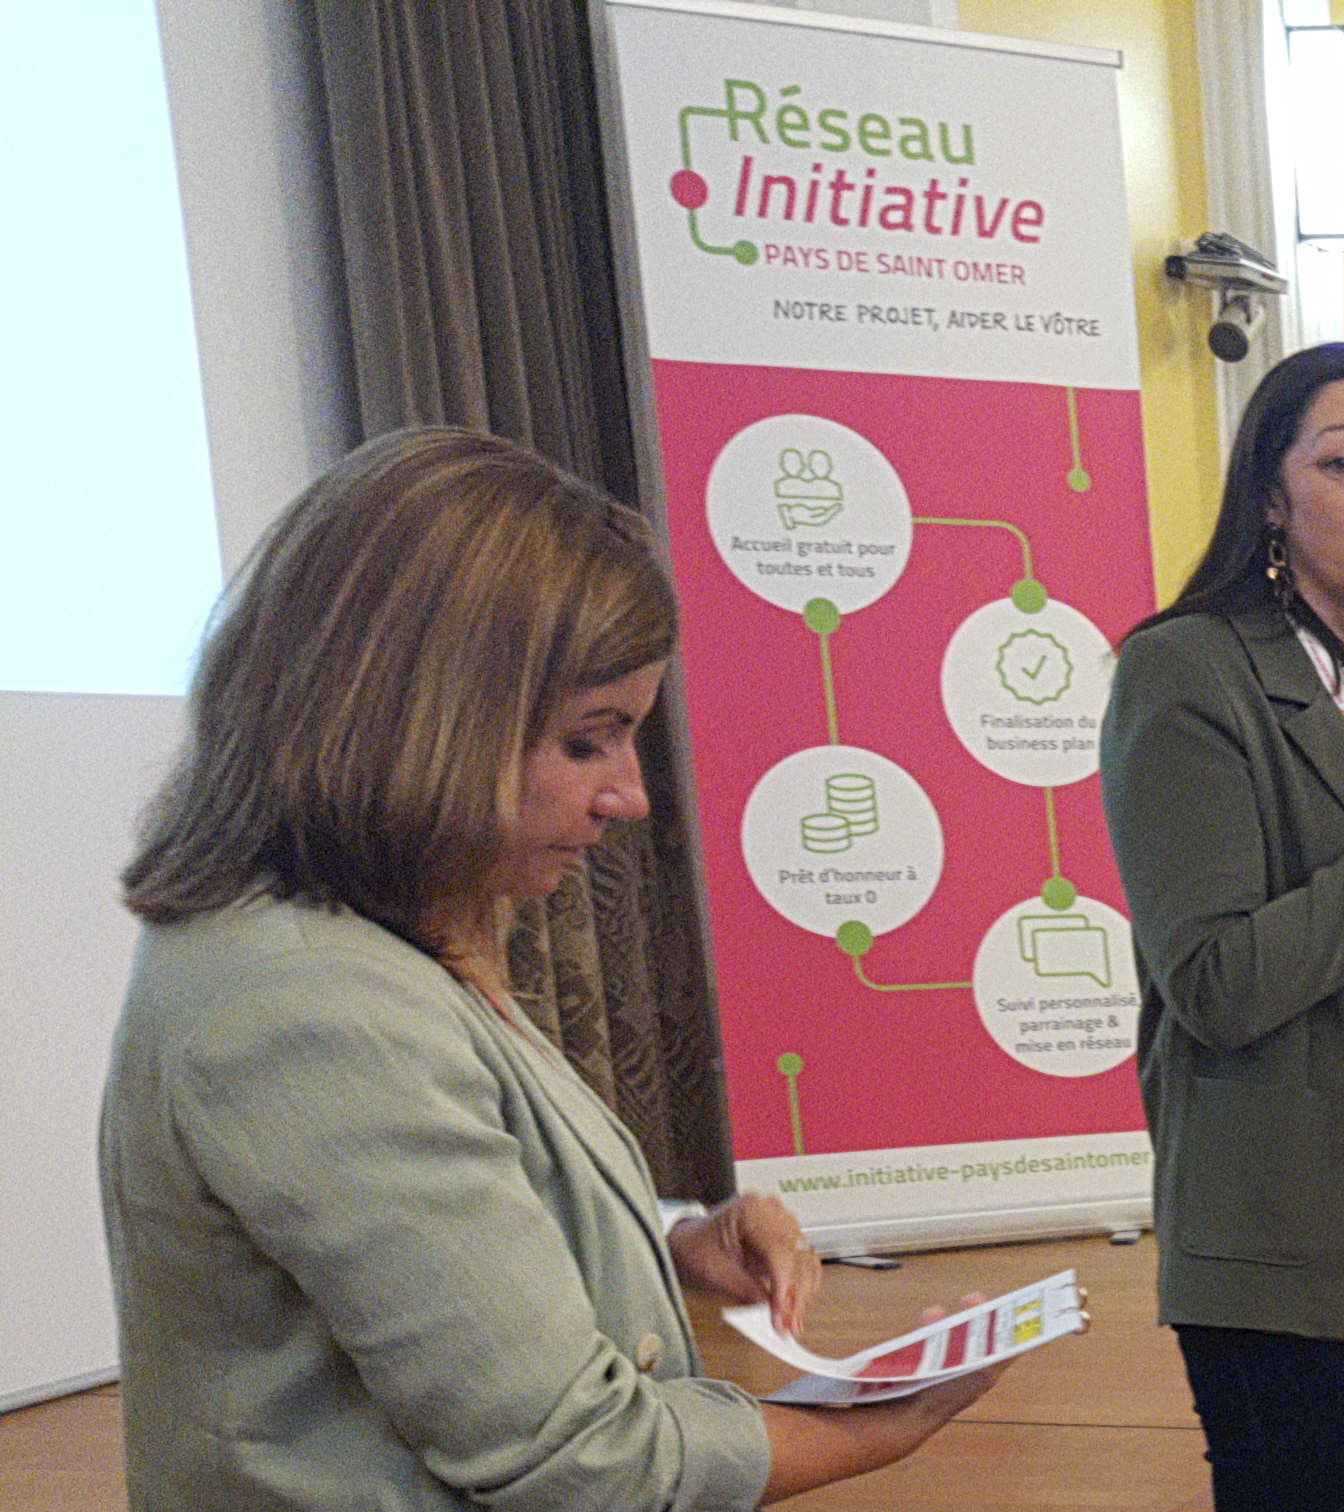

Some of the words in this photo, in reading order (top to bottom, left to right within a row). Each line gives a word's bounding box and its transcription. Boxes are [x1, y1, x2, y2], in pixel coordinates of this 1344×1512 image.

[724, 77, 976, 166] Réseau
[733, 155, 1046, 243] Initiative
[765, 244, 831, 271] PAYS
[838, 249, 869, 273] DE
[877, 253, 946, 281] SAINT
[953, 259, 1026, 286] OMER
[773, 300, 848, 322] NOTRE
[857, 304, 939, 332] PROJET,
[947, 310, 1008, 331] AIDER
[1015, 314, 1036, 332] LE
[1039, 312, 1103, 336] VÔTRE
[731, 536, 793, 552] Accueil
[796, 540, 853, 557] gratuit
[858, 544, 895, 557] pour
[756, 561, 812, 576] toutes
[816, 563, 834, 576] et
[837, 564, 875, 577] tous
[980, 713, 1074, 729] Finalisation
[1078, 714, 1097, 729] du
[986, 736, 1058, 750] business
[1062, 737, 1096, 753] plan
[778, 868, 815, 884] Prêt
[906, 865, 917, 880] à
[825, 892, 861, 905] taux
[997, 996, 1035, 1012] Suivi
[1019, 1016, 1104, 1035] parrainage
[1107, 1014, 1119, 1028] &
[1015, 1039, 1053, 1053] mise
[1057, 1041, 1077, 1052] en
[1080, 1035, 1132, 1050] réseau
